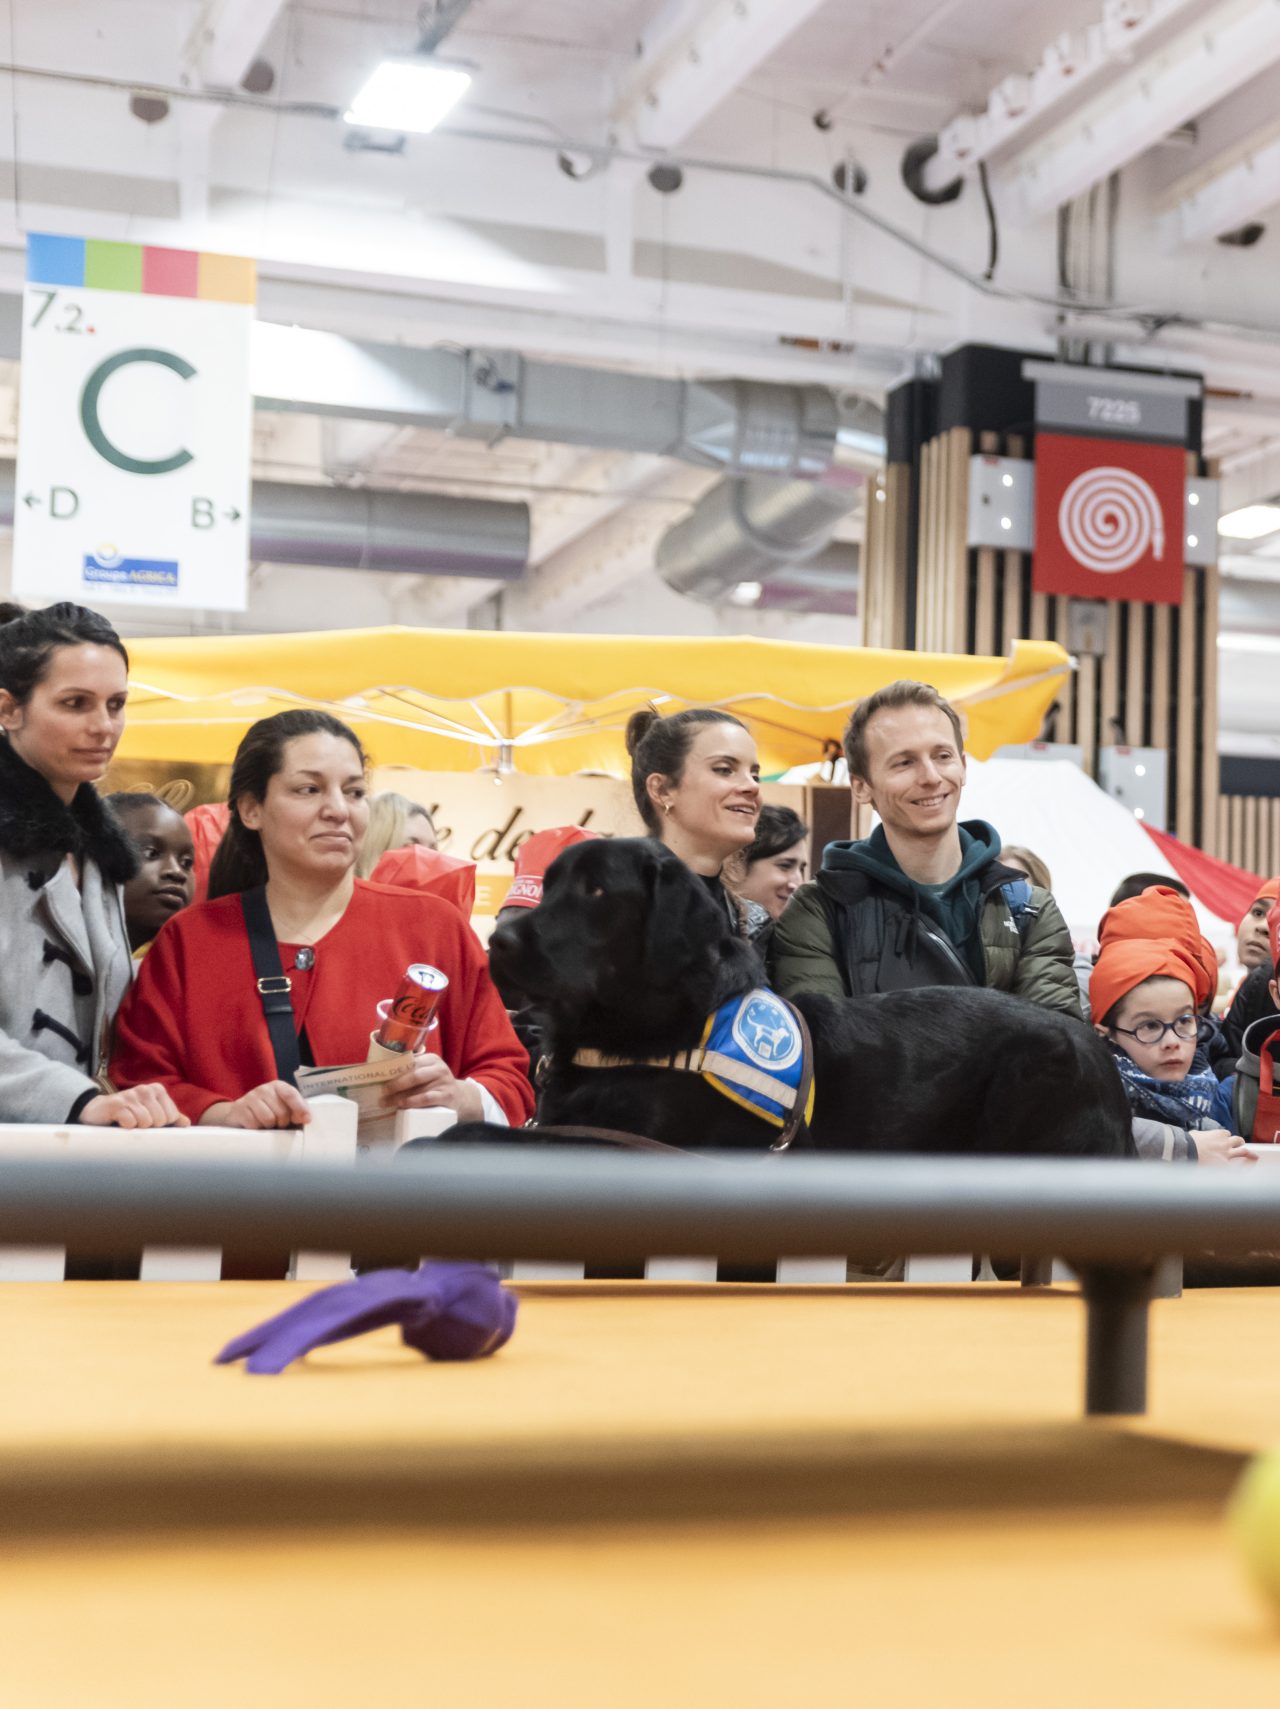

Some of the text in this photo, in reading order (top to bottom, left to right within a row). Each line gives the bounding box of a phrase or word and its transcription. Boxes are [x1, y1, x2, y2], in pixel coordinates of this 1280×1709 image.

[80, 347, 198, 475] C
[49, 487, 80, 520] D
[191, 497, 216, 530] B
[302, 1070, 387, 1090] INTERNATIONAL
[388, 1066, 402, 1076] DE
